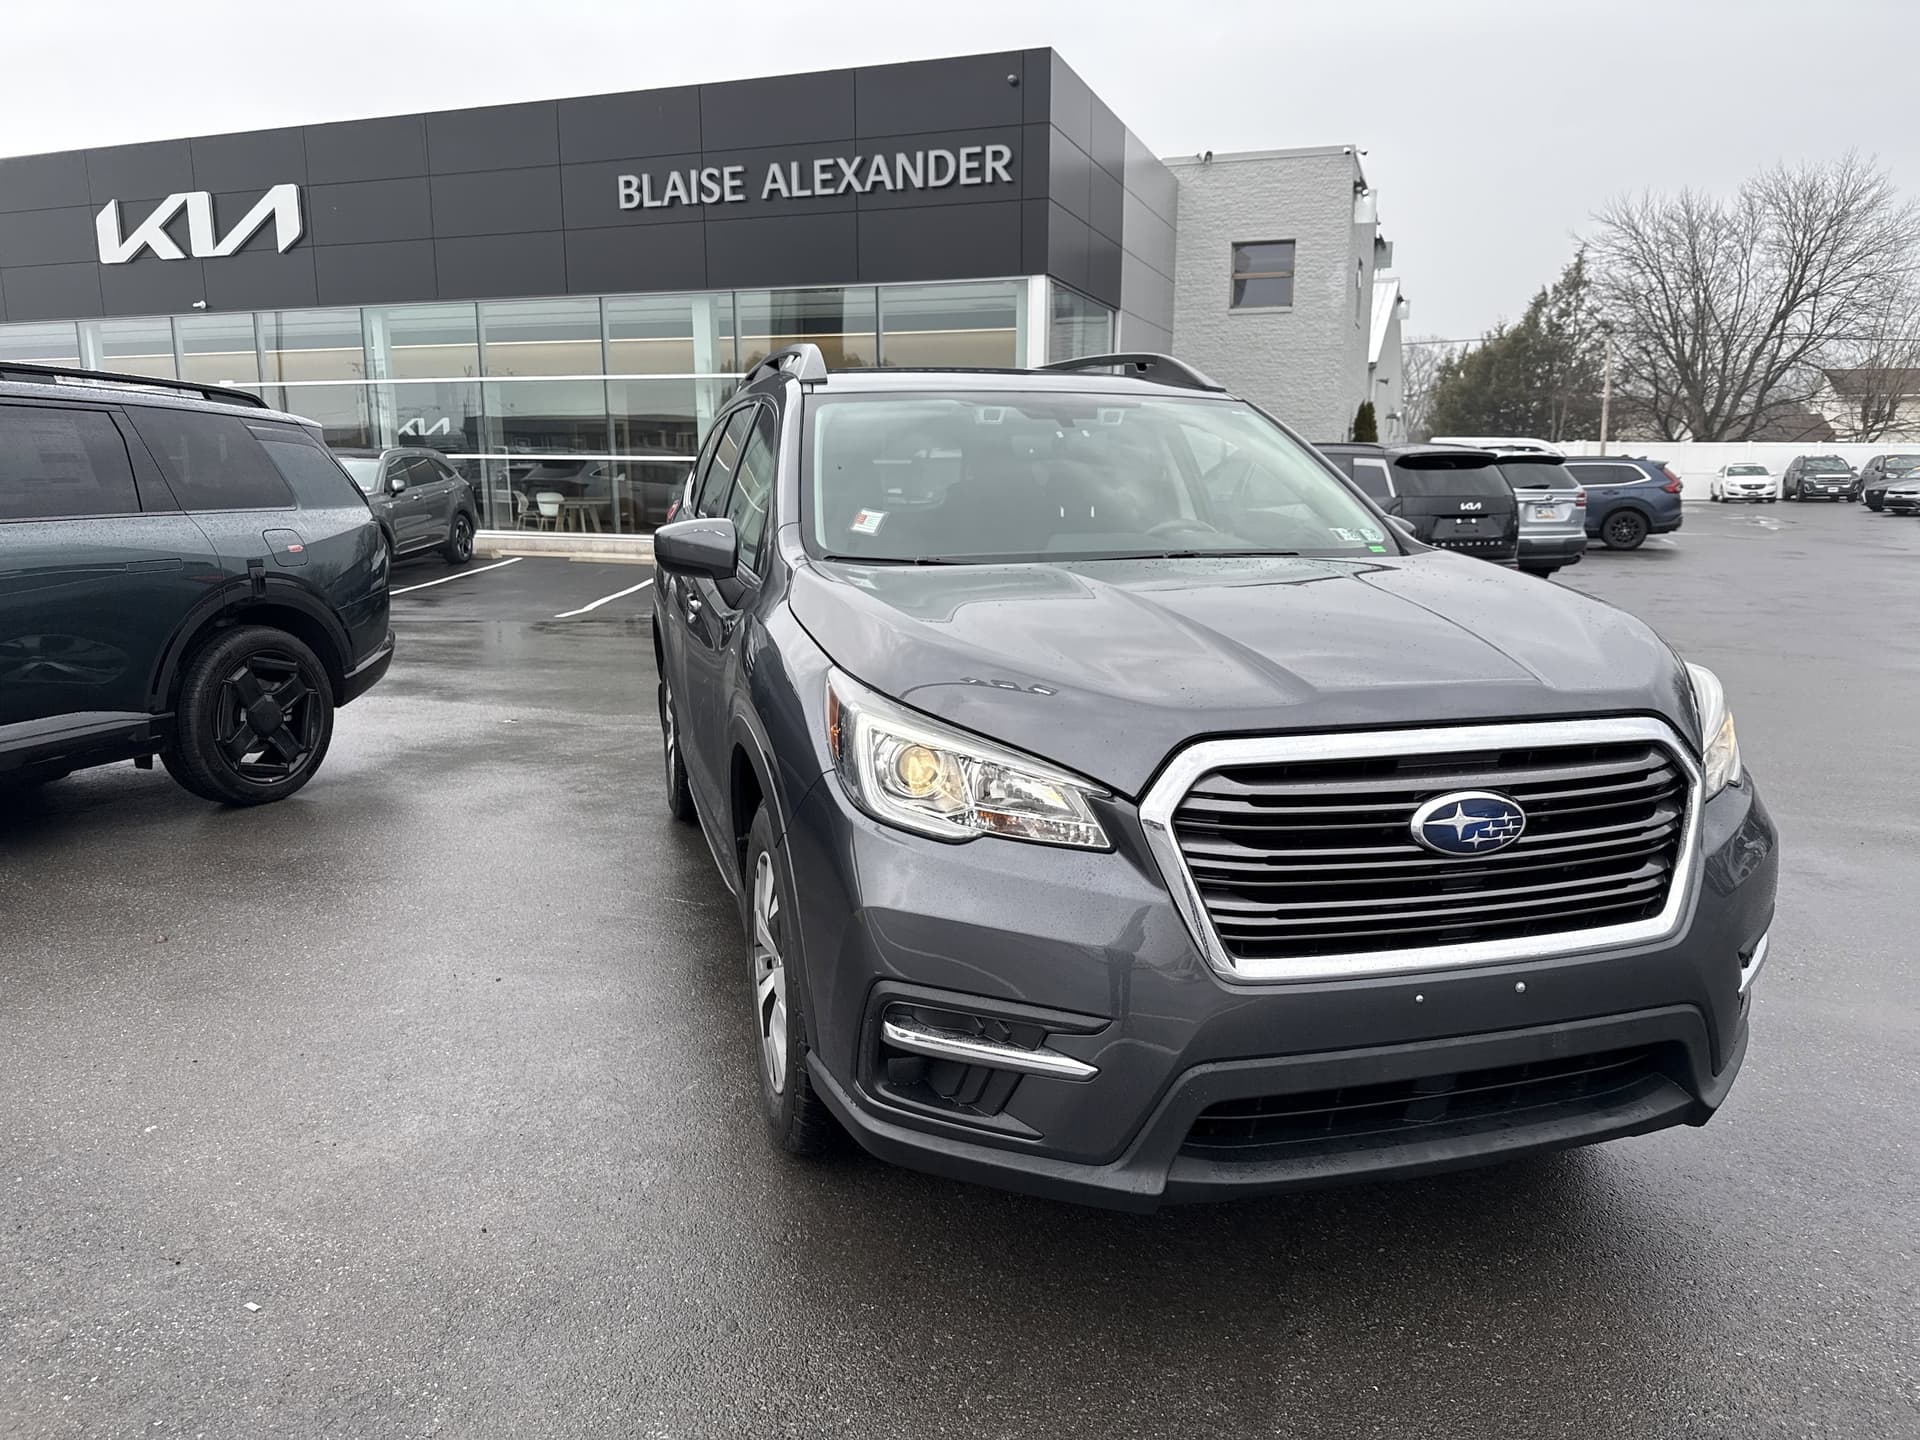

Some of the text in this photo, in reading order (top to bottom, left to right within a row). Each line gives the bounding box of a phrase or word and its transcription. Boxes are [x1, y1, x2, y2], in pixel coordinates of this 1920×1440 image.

[617, 144, 1013, 210] BLAISE ALEXANDER
[96, 183, 303, 264] KIA
[1460, 502, 1482, 510] KIA
